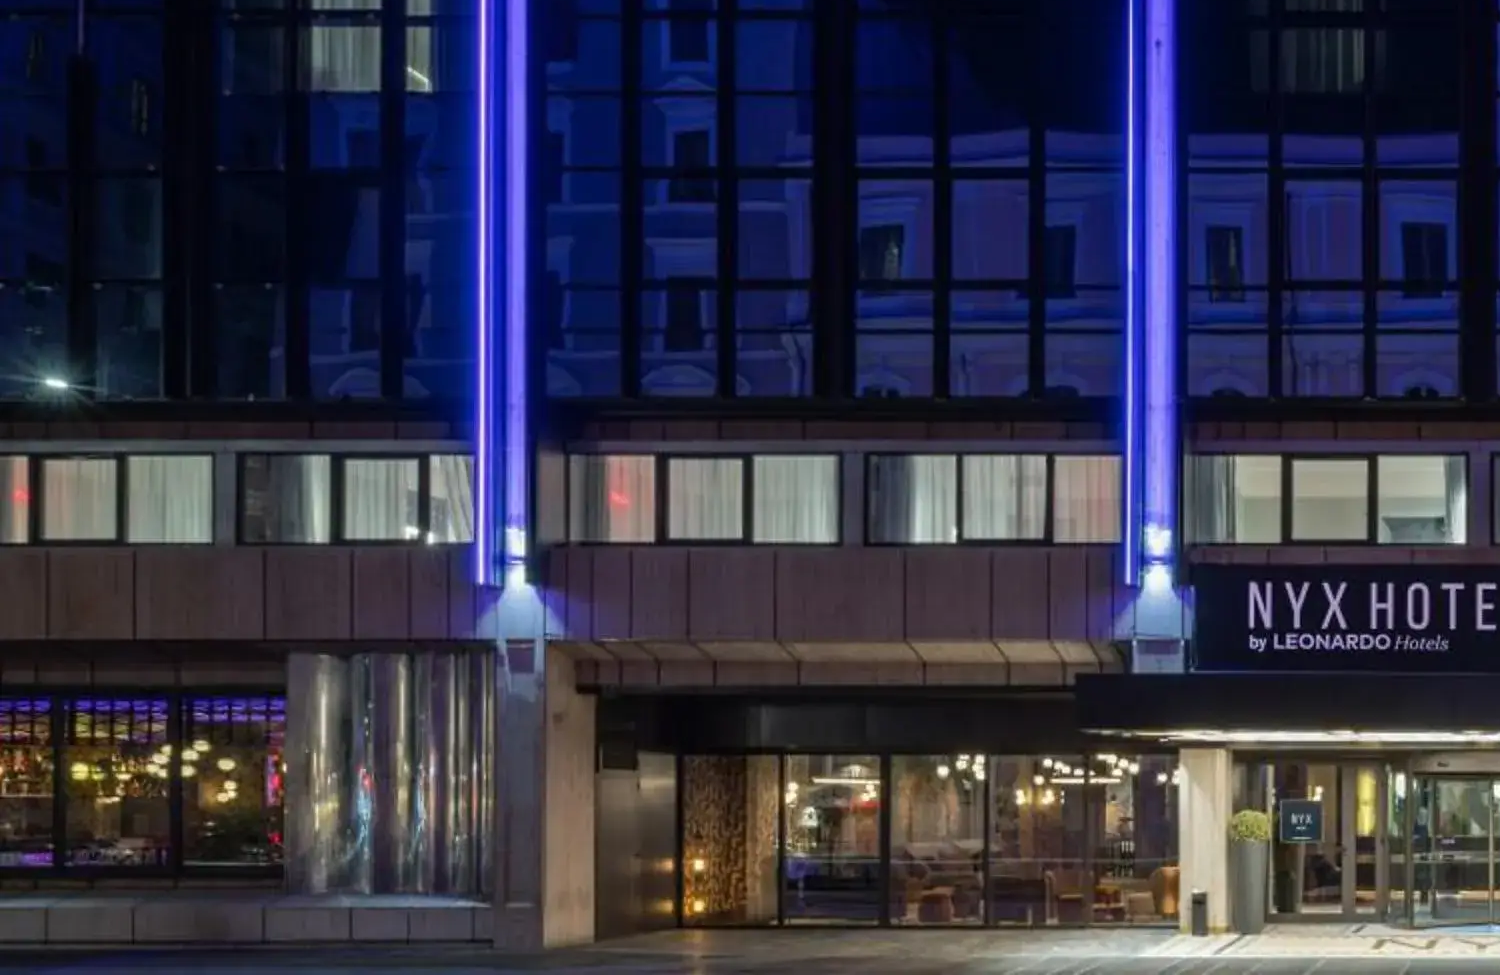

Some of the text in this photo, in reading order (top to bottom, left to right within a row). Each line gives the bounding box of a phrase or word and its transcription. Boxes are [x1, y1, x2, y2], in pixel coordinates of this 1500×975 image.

[1248, 581, 1348, 630] NYX
[1249, 633, 1449, 652] by LEONARDO Hotels
[1291, 813, 1313, 825] NYX
